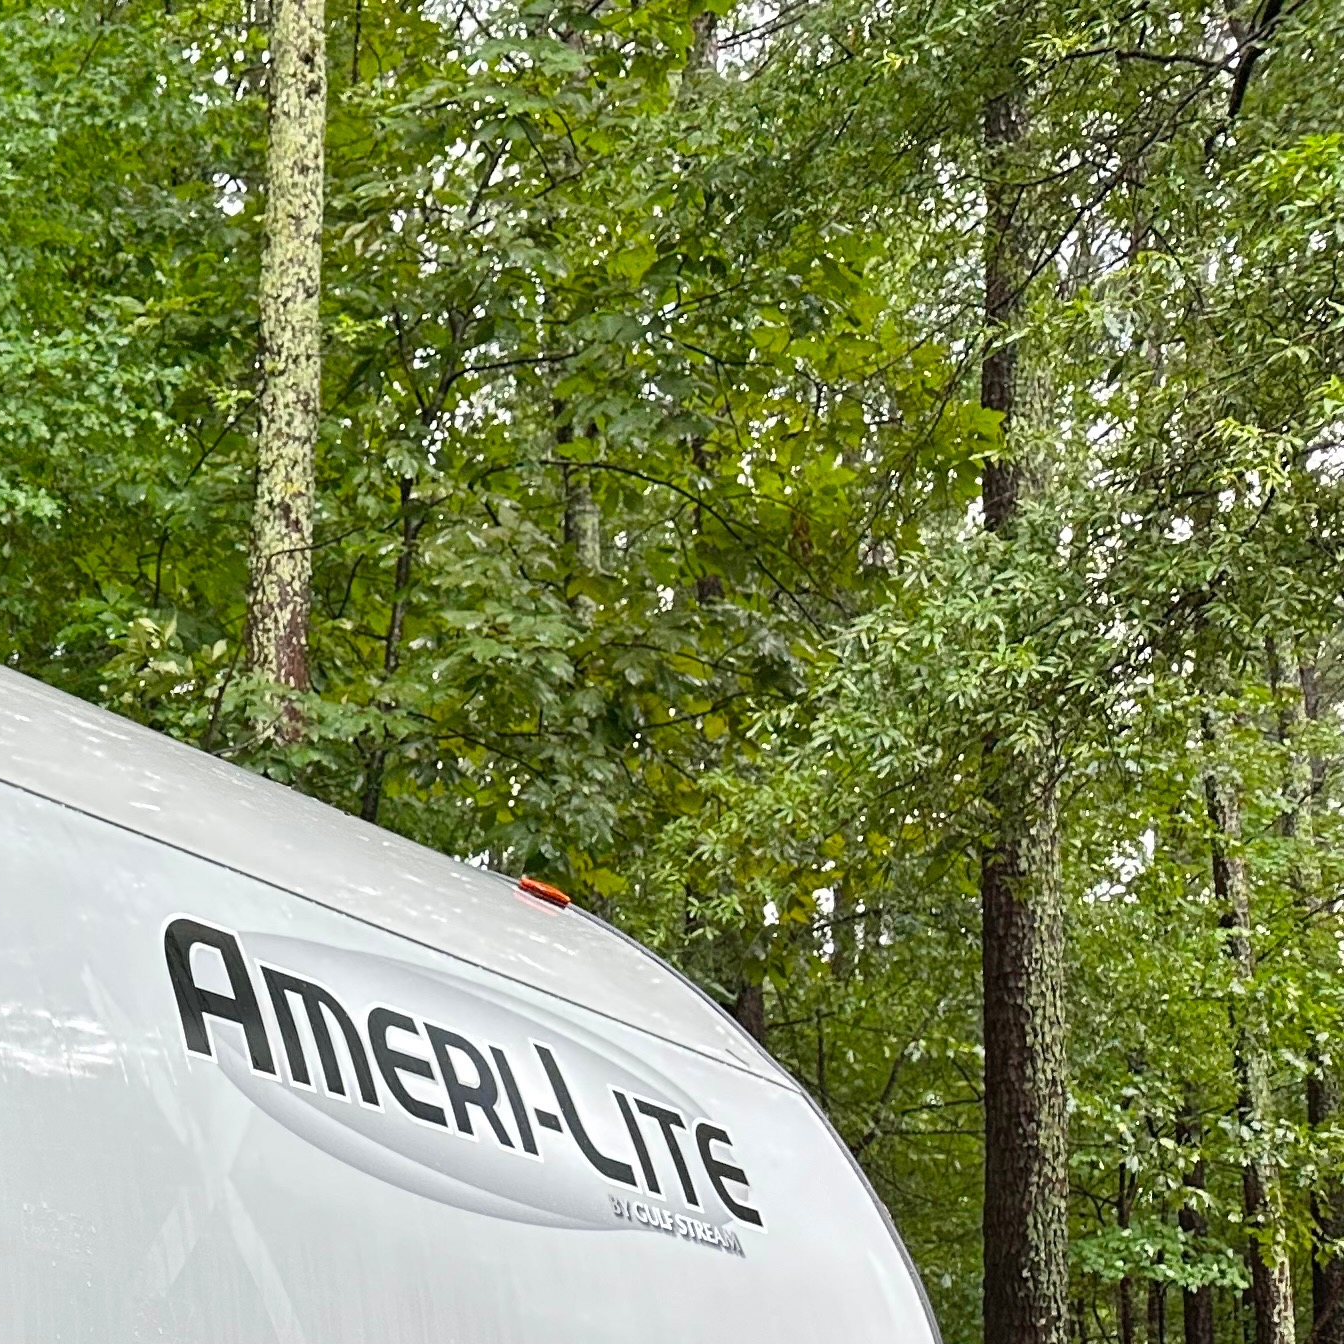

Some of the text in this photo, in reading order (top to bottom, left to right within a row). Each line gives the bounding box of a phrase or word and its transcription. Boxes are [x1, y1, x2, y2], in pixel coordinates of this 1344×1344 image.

[609, 1194, 745, 1258] BY GULF STREAM
